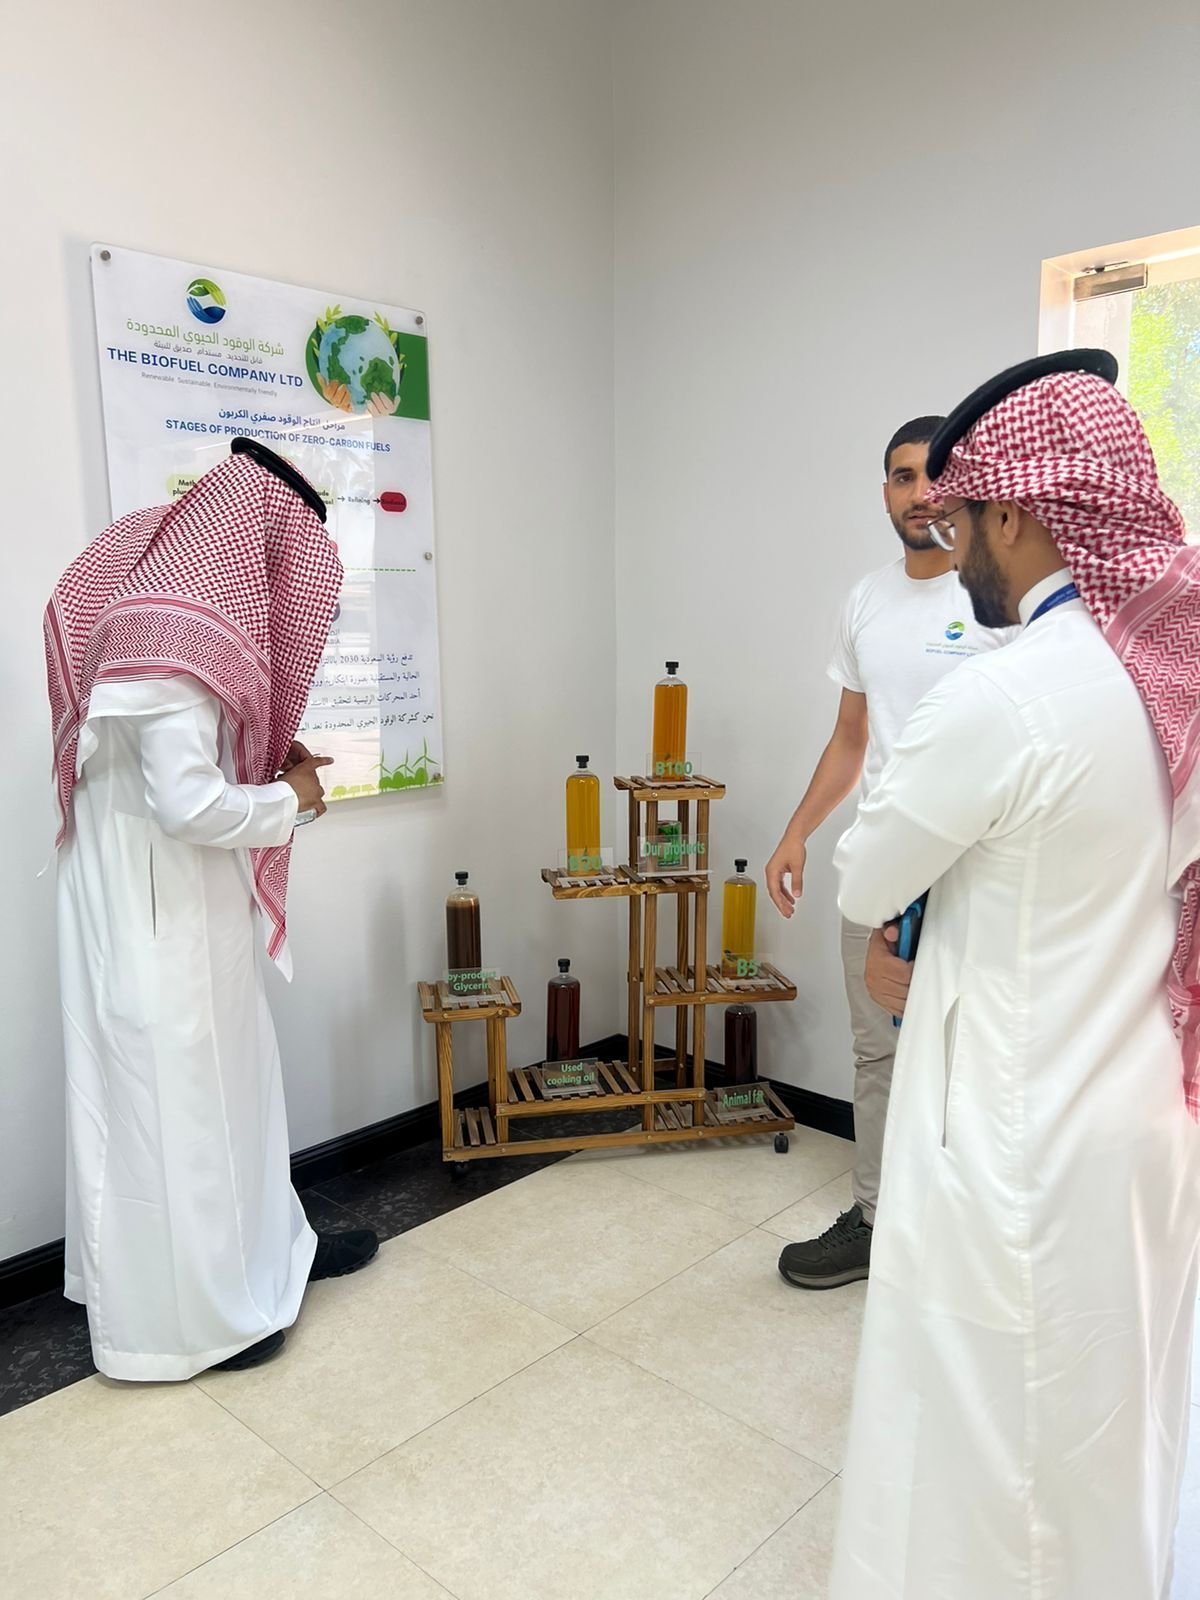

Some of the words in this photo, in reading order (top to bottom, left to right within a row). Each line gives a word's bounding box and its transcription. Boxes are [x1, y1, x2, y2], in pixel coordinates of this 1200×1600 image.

[127, 318, 180, 338] المحدودة
[183, 330, 219, 345] الحيوي
[223, 337, 255, 351] الوقود
[258, 341, 285, 356] شركة
[107, 347, 137, 363] THE
[141, 352, 205, 373] BIOFUEL
[208, 363, 276, 384] COMPANY
[279, 374, 303, 387] LTD
[219, 408, 249, 419] الكربون
[250, 412, 276, 424] صفري
[278, 413, 302, 426] الوقود
[165, 419, 207, 433] STAGES
[209, 424, 223, 434] OF
[224, 426, 287, 441] PRODUCTION
[288, 432, 301, 442] OF
[302, 434, 365, 450] ZERO-CARBON
[366, 440, 391, 452] FUELS
[340, 655, 359, 664] 2030
[325, 718, 355, 730] المحدودة
[357, 716, 378, 729] الحيوي
[380, 714, 397, 726] الوقود
[398, 711, 420, 724] كشركة
[655, 761, 693, 776] B100
[644, 841, 661, 857] Our
[664, 839, 705, 861] products
[736, 958, 758, 977] B5
[561, 1062, 583, 1073] Used
[547, 1073, 582, 1086] cooking
[583, 1072, 595, 1083] oil
[722, 1091, 751, 1108] Animal
[752, 1089, 765, 1104] fat
